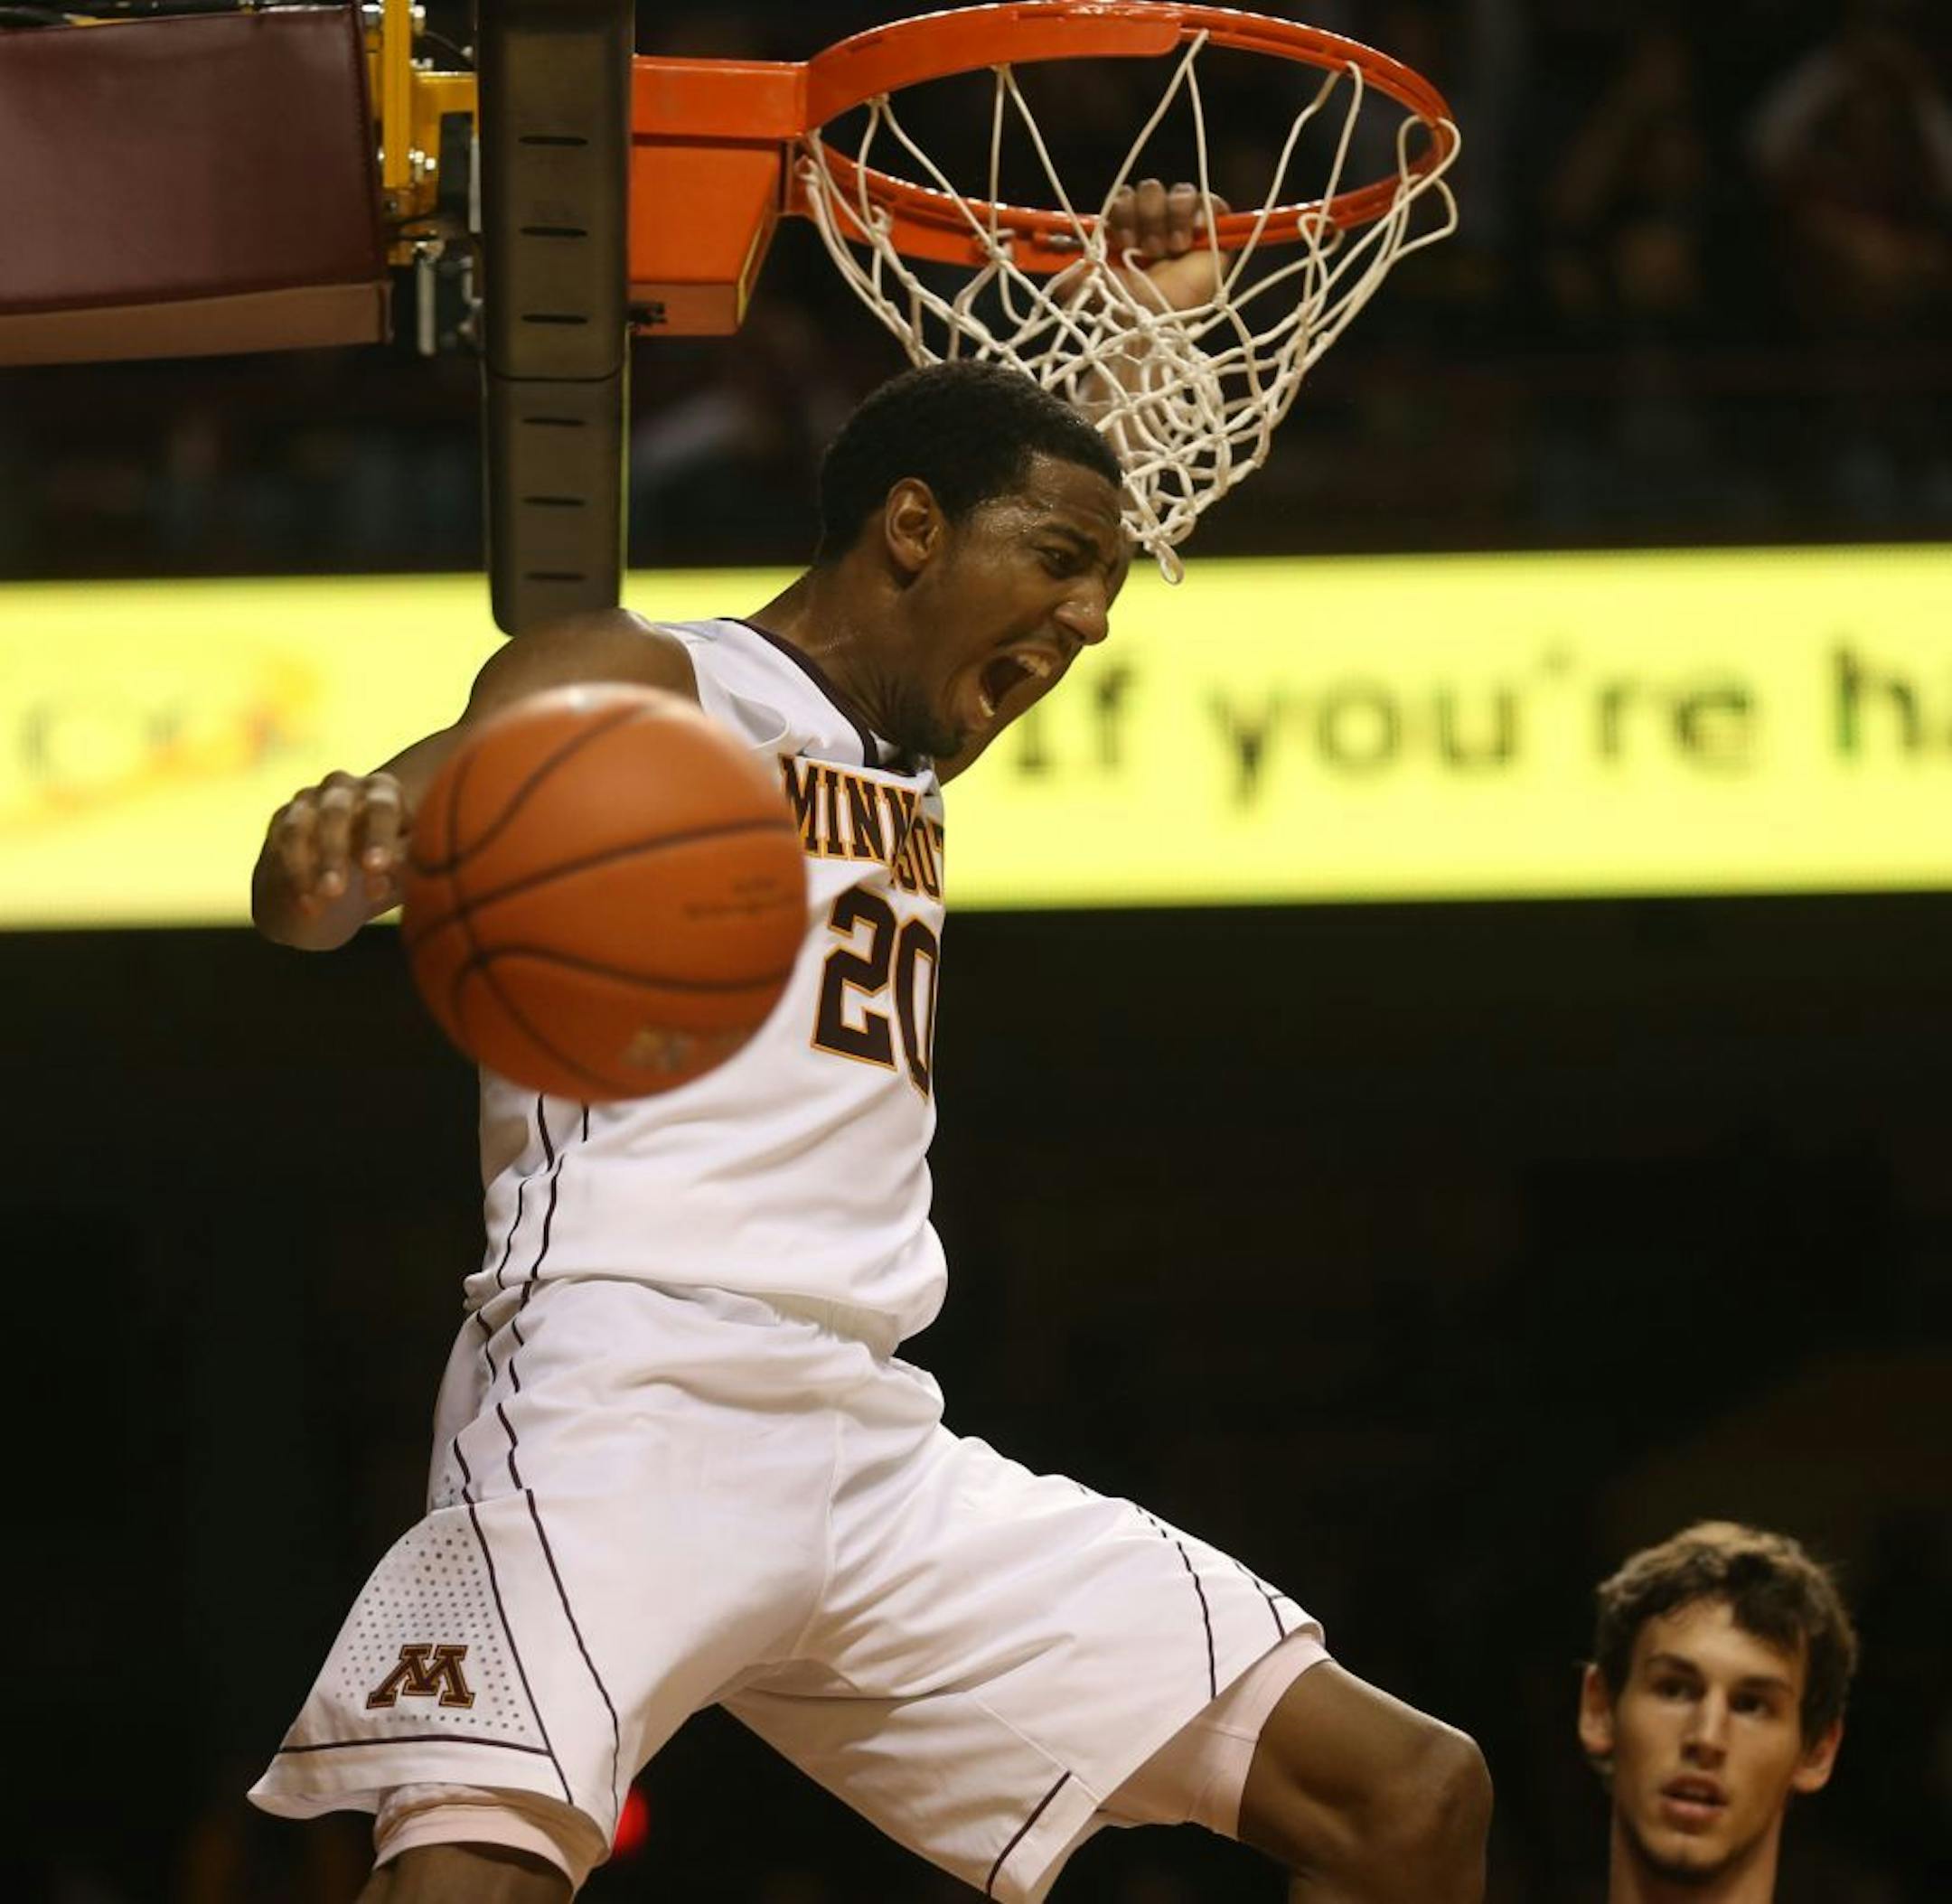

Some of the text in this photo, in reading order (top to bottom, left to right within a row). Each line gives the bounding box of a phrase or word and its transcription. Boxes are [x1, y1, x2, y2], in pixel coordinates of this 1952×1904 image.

[1207, 643, 1760, 811] you're
[1829, 636, 1952, 766] h
[810, 882, 938, 1102] 20
[366, 1644, 476, 1710] M
